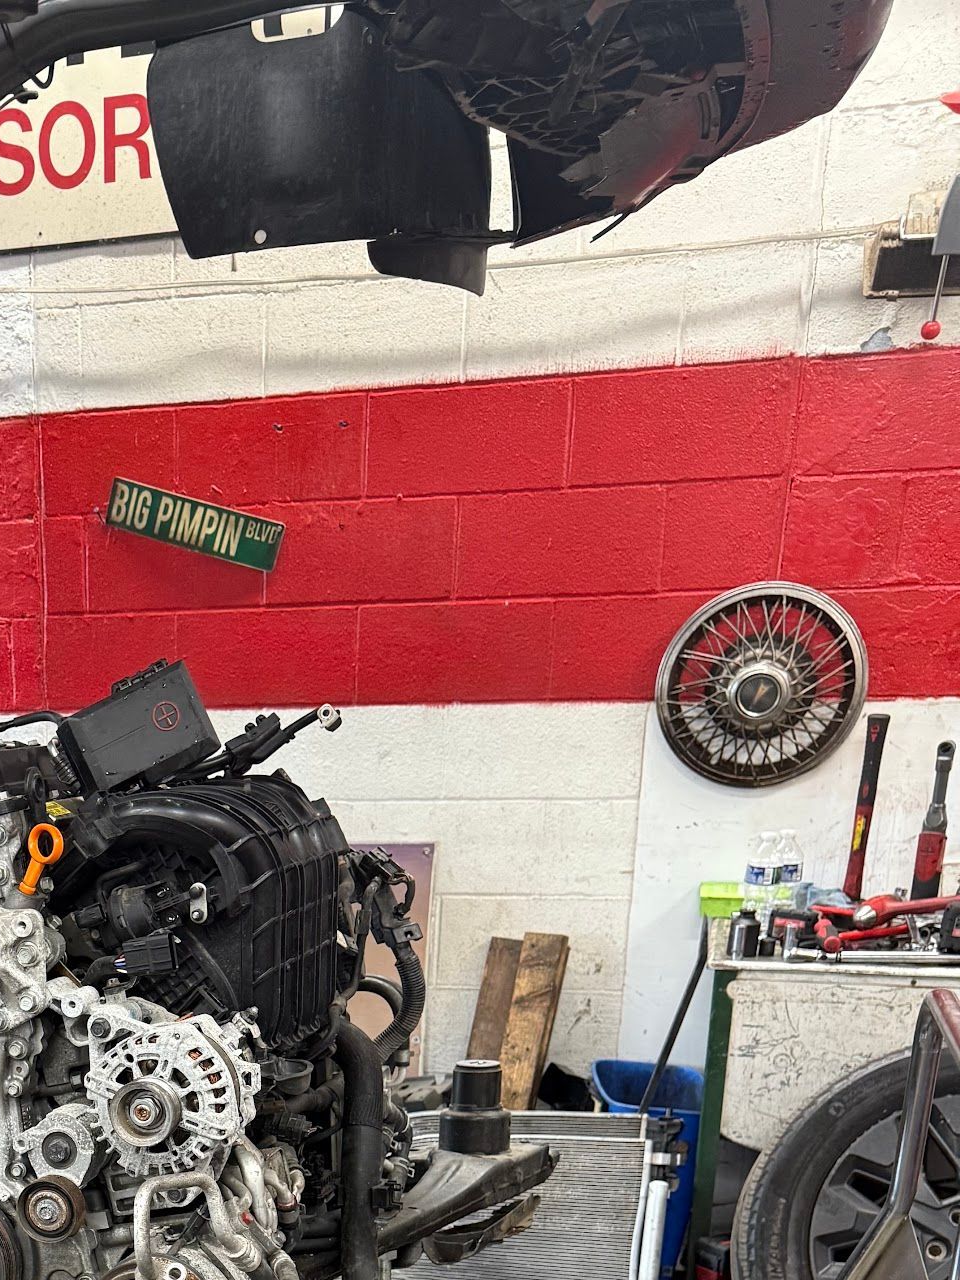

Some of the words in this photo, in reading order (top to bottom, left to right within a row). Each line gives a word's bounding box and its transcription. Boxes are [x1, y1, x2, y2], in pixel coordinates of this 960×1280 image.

[111, 482, 153, 530] BIG
[153, 496, 245, 557] PIMPIN
[245, 520, 281, 545] BLVD
